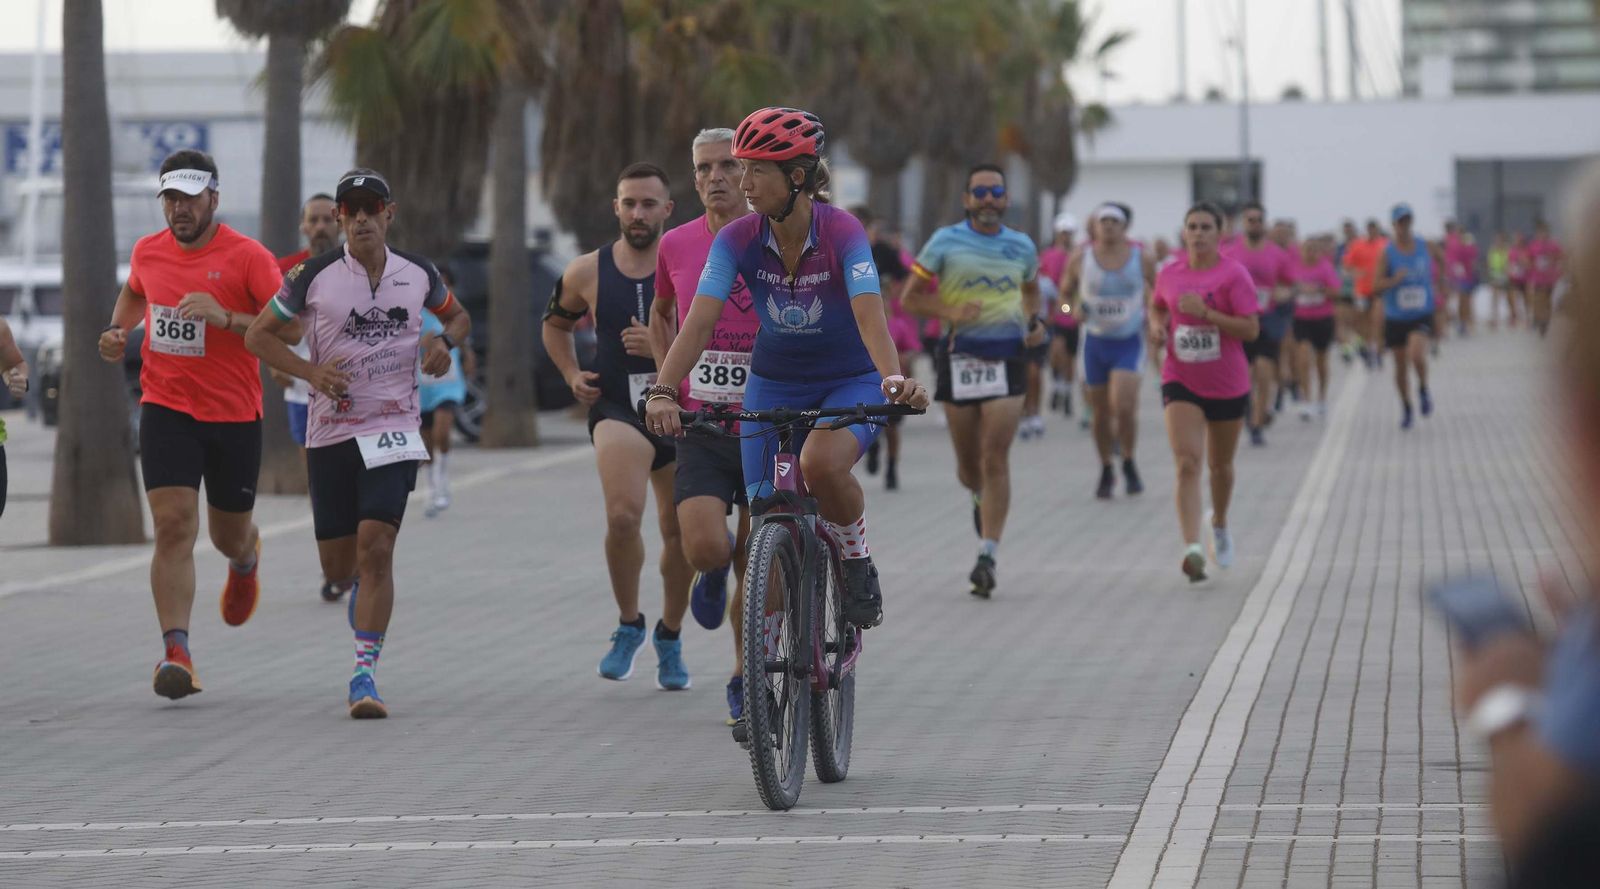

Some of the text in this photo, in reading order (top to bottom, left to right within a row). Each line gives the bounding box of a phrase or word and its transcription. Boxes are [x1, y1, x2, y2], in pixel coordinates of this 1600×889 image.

[156, 319, 196, 341] 368
[1180, 335, 1213, 349] 398
[698, 364, 747, 387] 389
[960, 367, 998, 386] 878
[377, 432, 408, 449] 49
